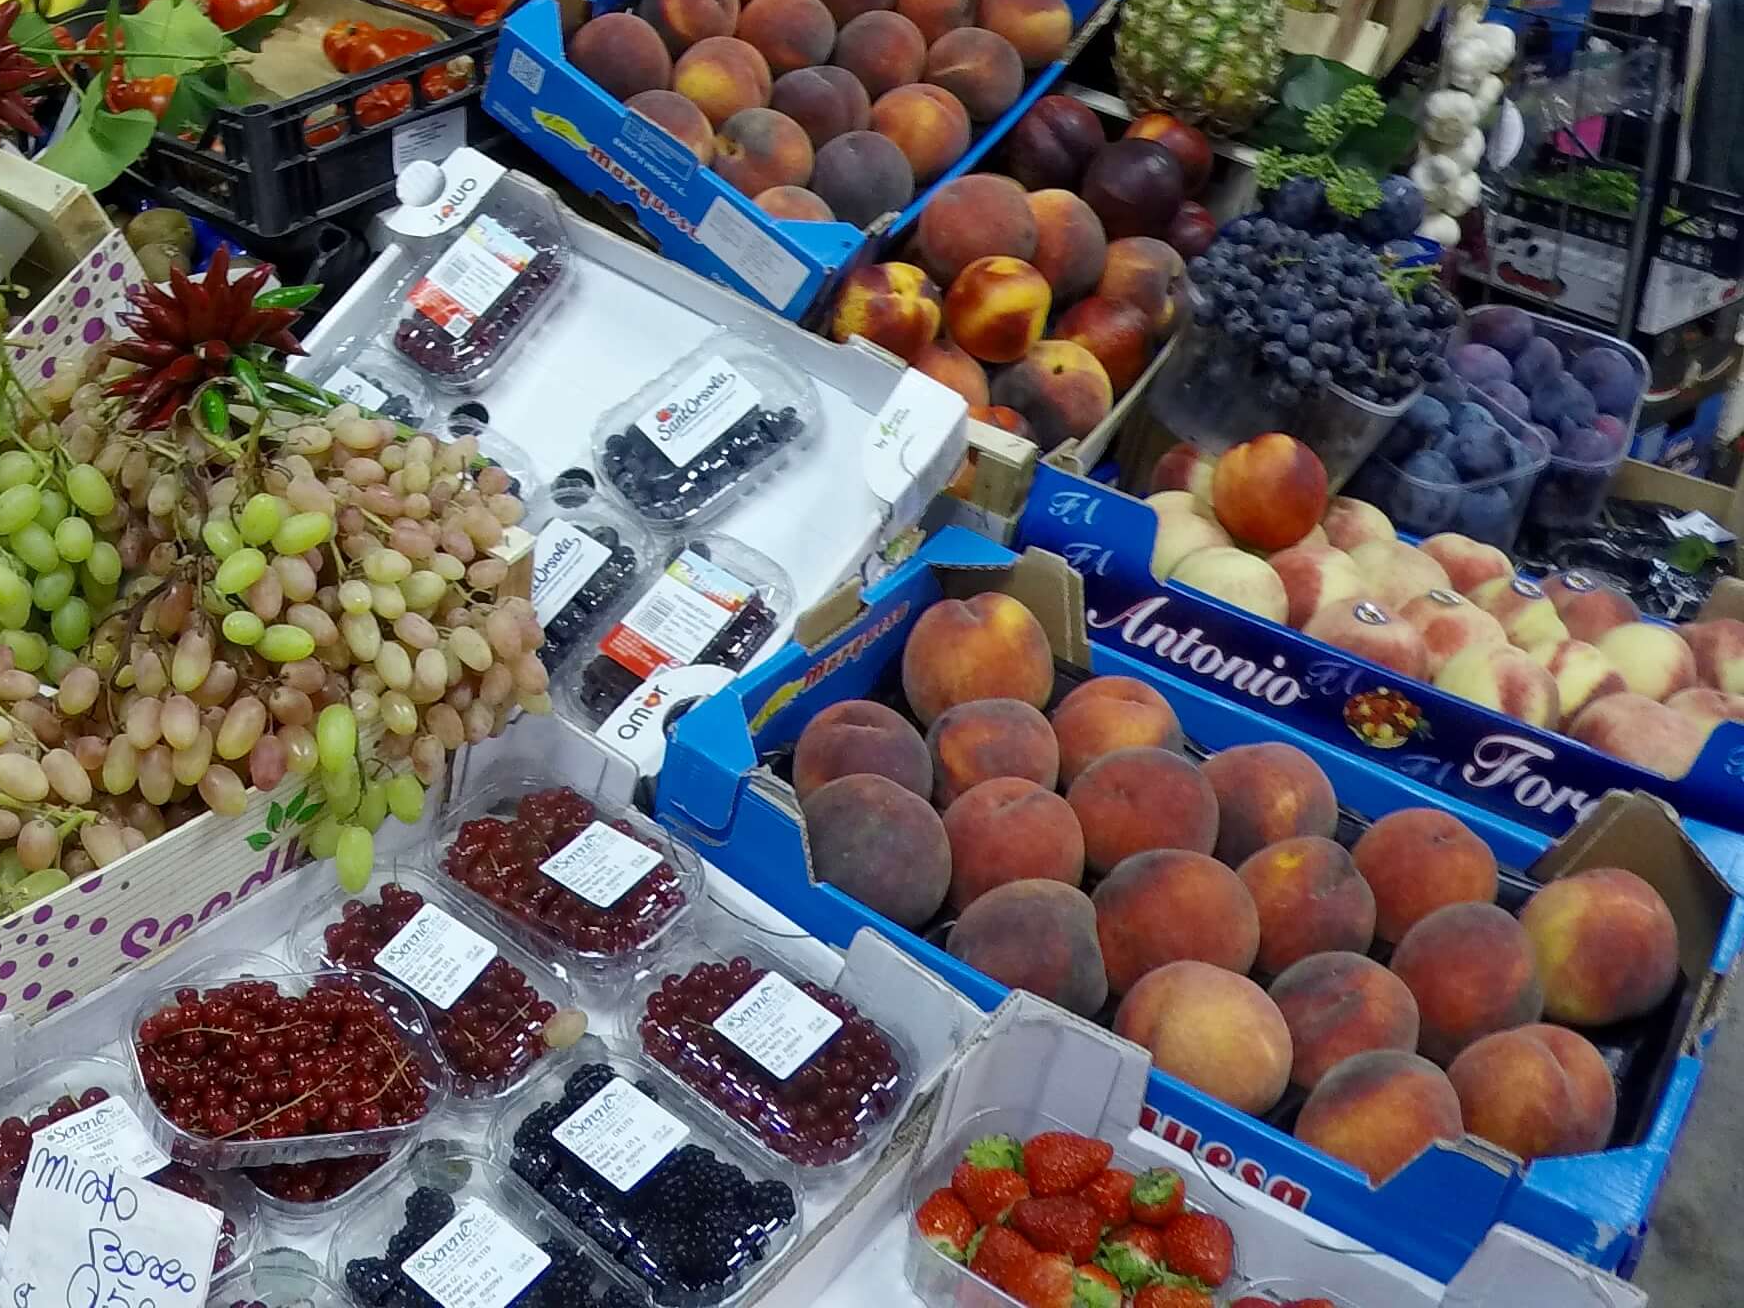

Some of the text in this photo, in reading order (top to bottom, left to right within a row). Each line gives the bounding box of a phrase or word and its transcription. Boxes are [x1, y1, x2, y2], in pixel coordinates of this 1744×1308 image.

[586, 142, 705, 244] marques
[1088, 596, 1311, 709] Antonio
[1138, 1105, 1311, 1211] uesa
